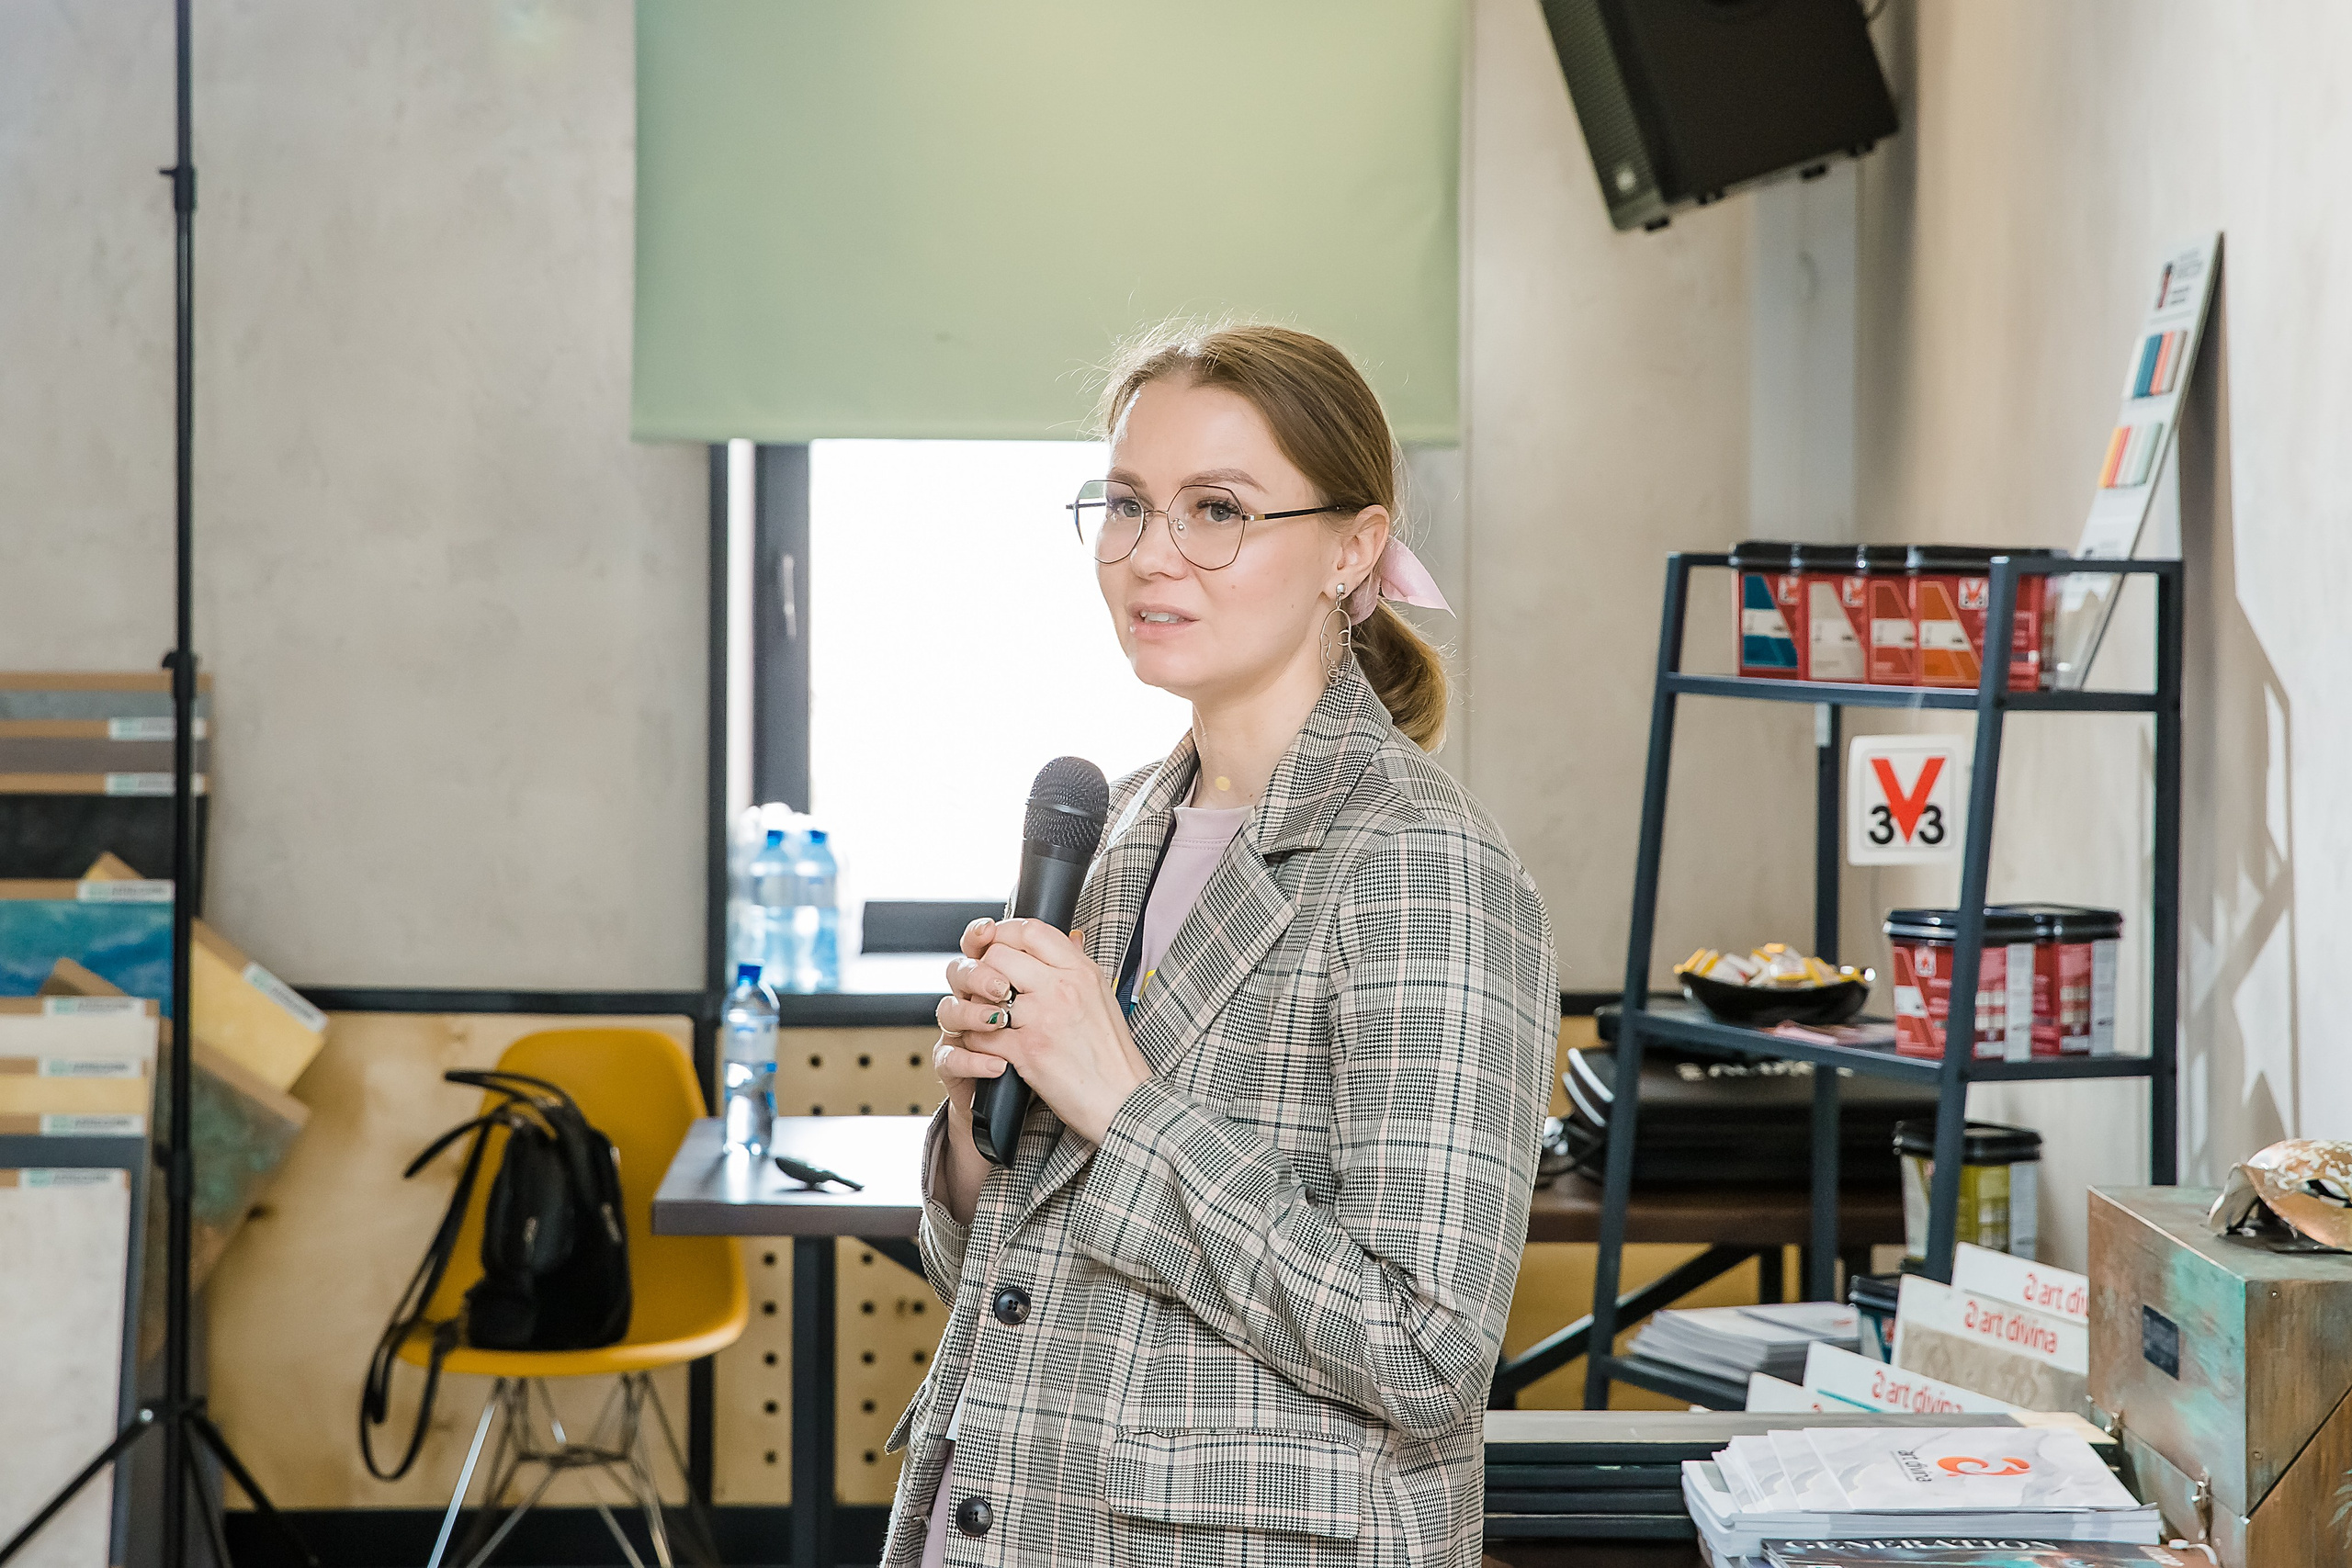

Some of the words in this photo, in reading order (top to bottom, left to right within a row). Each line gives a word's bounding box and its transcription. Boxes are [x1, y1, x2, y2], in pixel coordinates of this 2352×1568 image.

[1979, 1311, 2004, 1338] art
[2006, 1314, 2058, 1354] divina
[1886, 1382, 1910, 1409] art
[1784, 1539, 2060, 1551] GENERATION
